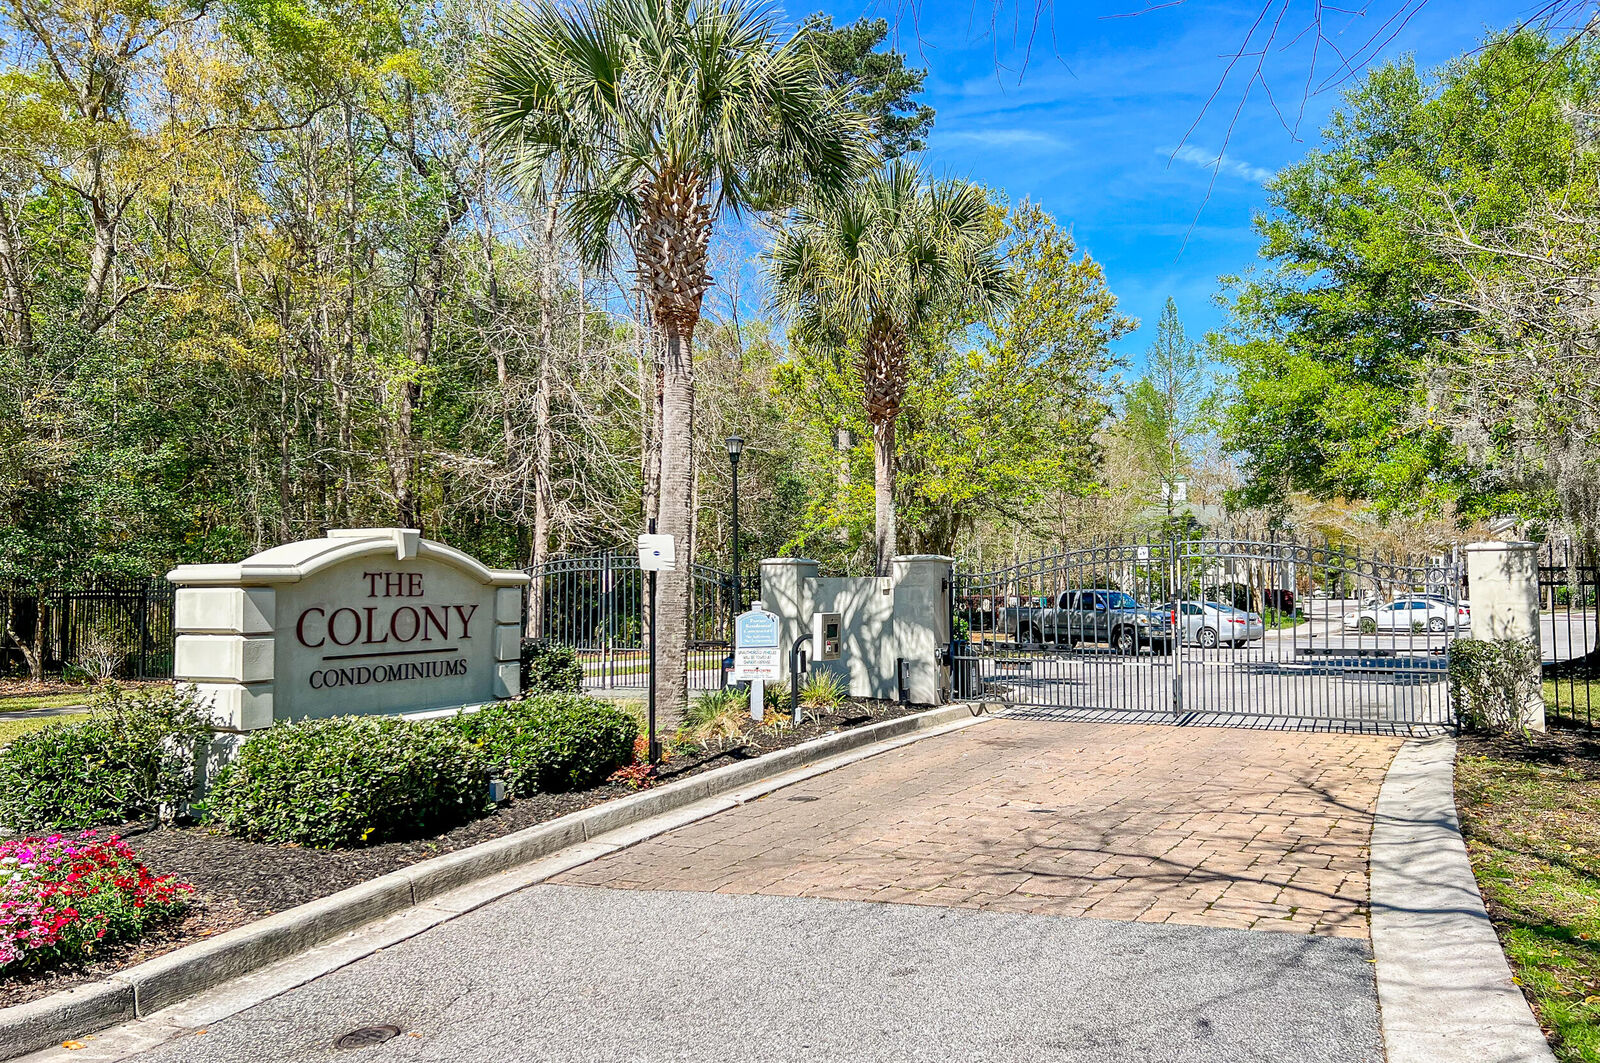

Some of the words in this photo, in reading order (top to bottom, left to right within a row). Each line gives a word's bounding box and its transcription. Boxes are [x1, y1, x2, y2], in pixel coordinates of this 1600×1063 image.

[363, 571, 424, 598] THE
[296, 604, 480, 648] COLONY
[309, 659, 468, 690] CONDOMINIUMS
